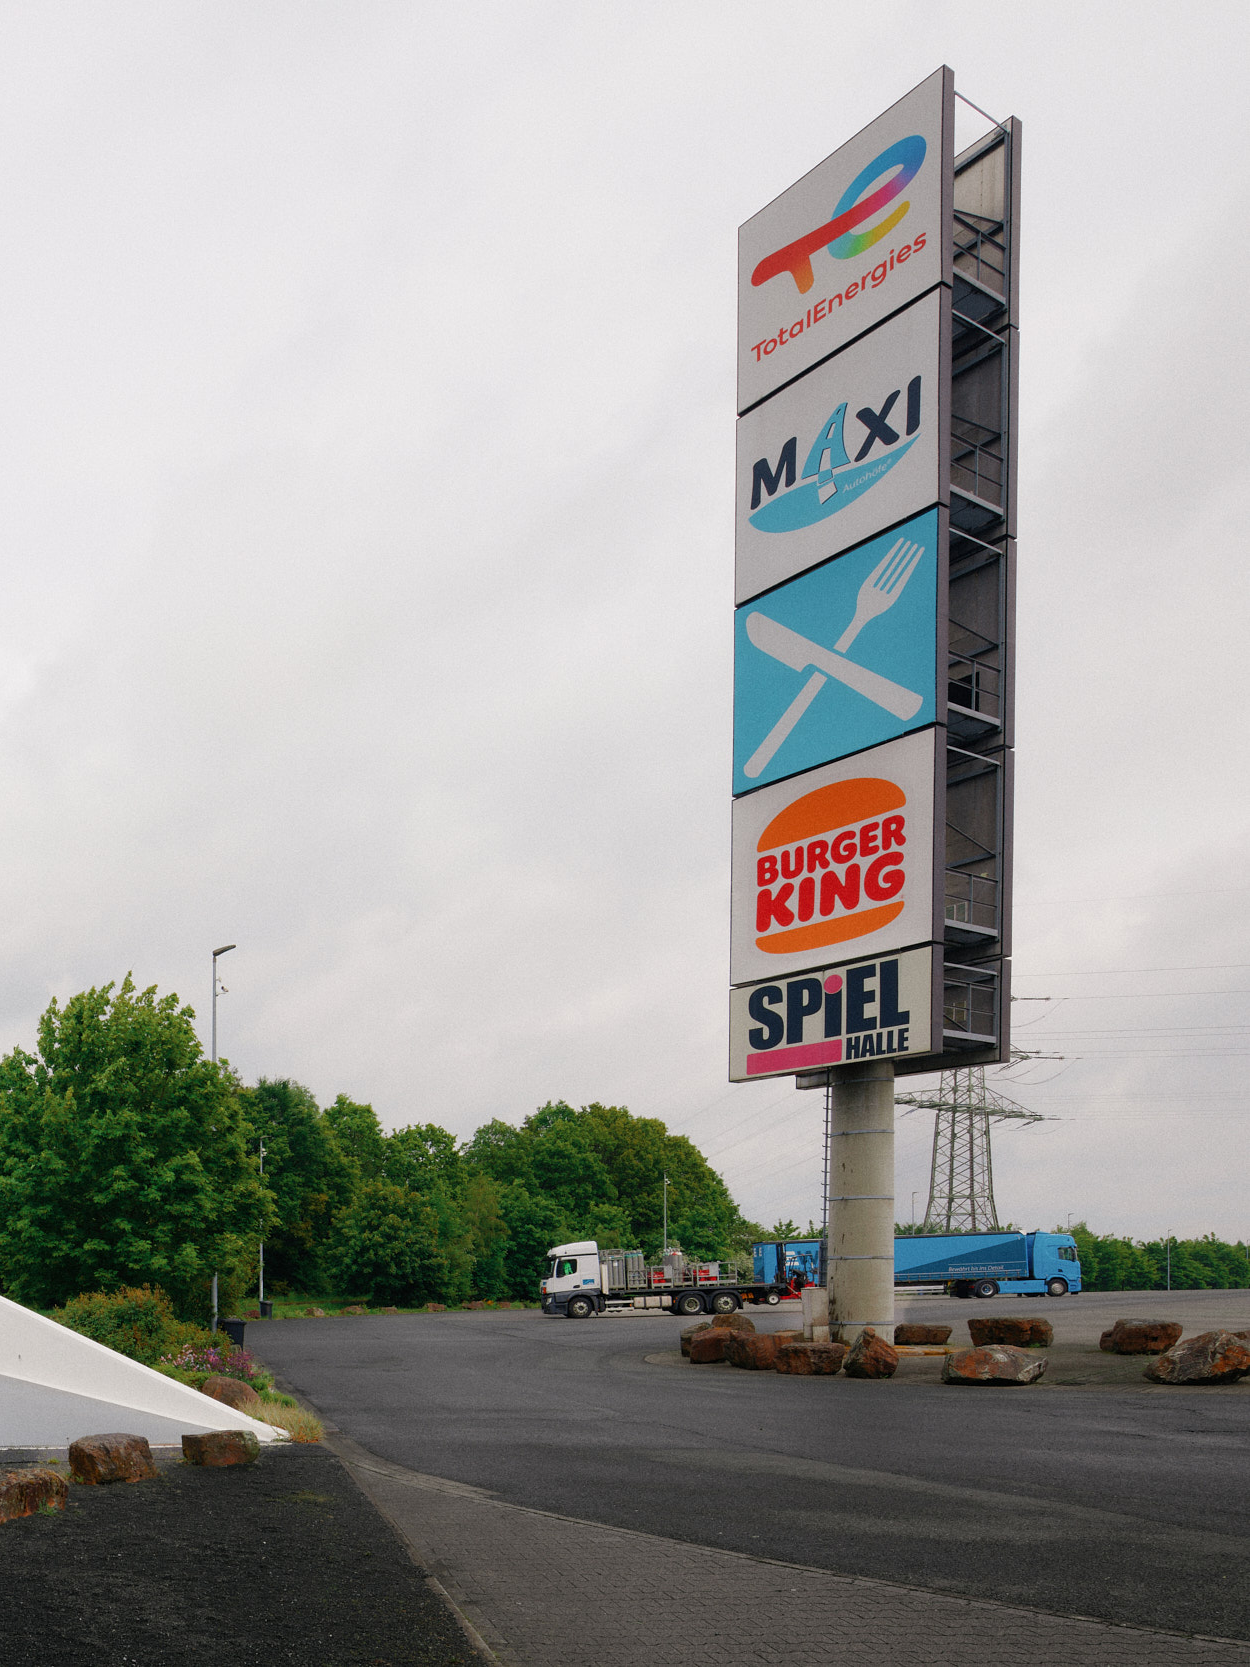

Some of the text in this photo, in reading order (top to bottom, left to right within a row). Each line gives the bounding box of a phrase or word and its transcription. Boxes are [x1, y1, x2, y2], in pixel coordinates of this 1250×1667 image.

[751, 232, 927, 362] TotalEnergies
[750, 375, 921, 510] MAXI
[756, 851, 906, 932] KING
[757, 815, 906, 887] BURGER
[846, 1027, 909, 1060] HALLE
